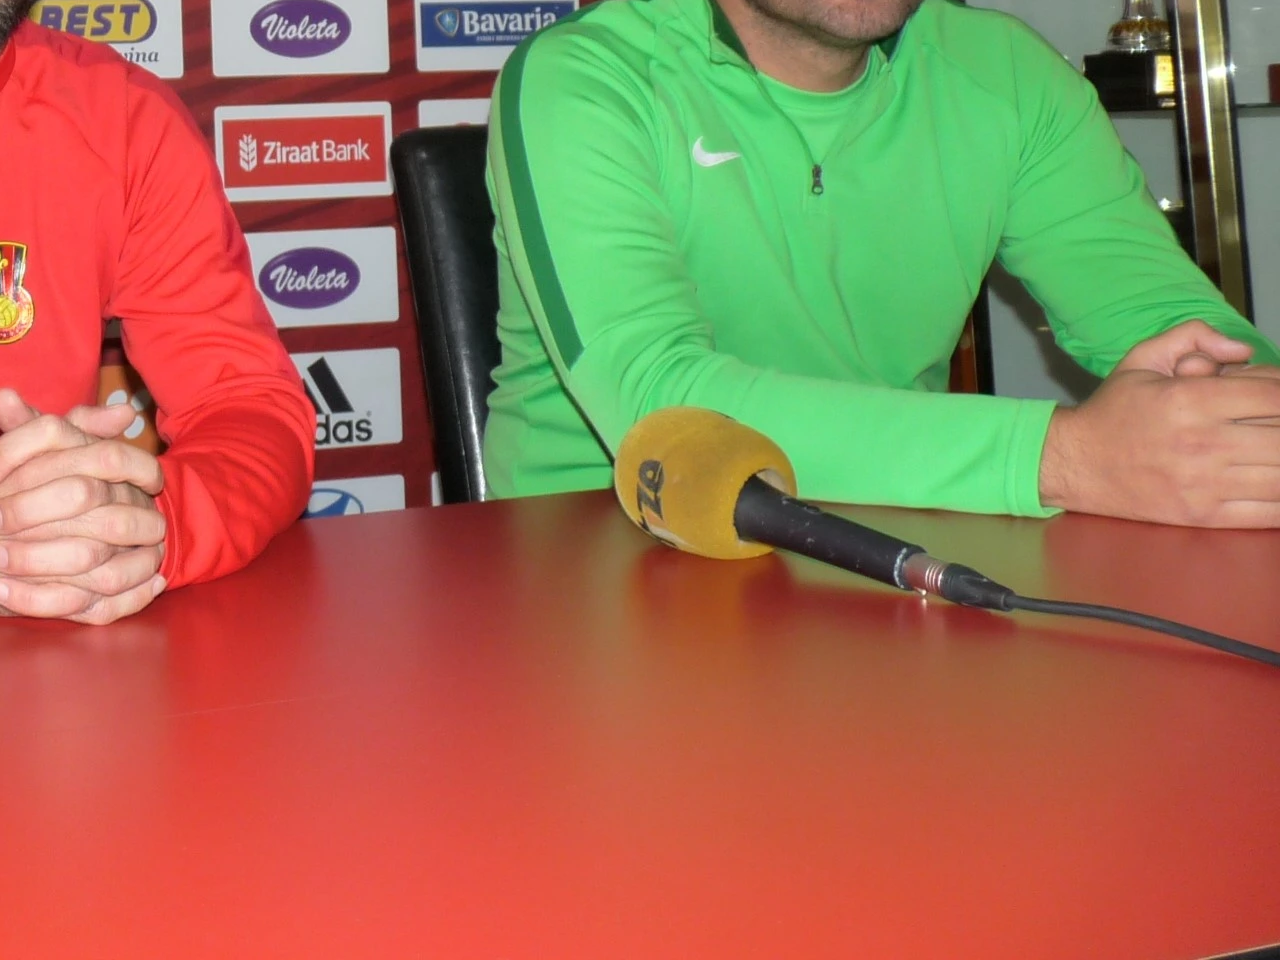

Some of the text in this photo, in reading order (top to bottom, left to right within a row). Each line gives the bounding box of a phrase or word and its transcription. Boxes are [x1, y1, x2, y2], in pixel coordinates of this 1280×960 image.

[40, 3, 141, 37] BEST
[261, 14, 340, 40] Violeta
[463, 7, 557, 36] Bavaria
[264, 139, 370, 165] Ziraat Bank
[269, 264, 350, 293] Violeta
[315, 414, 373, 445] das
